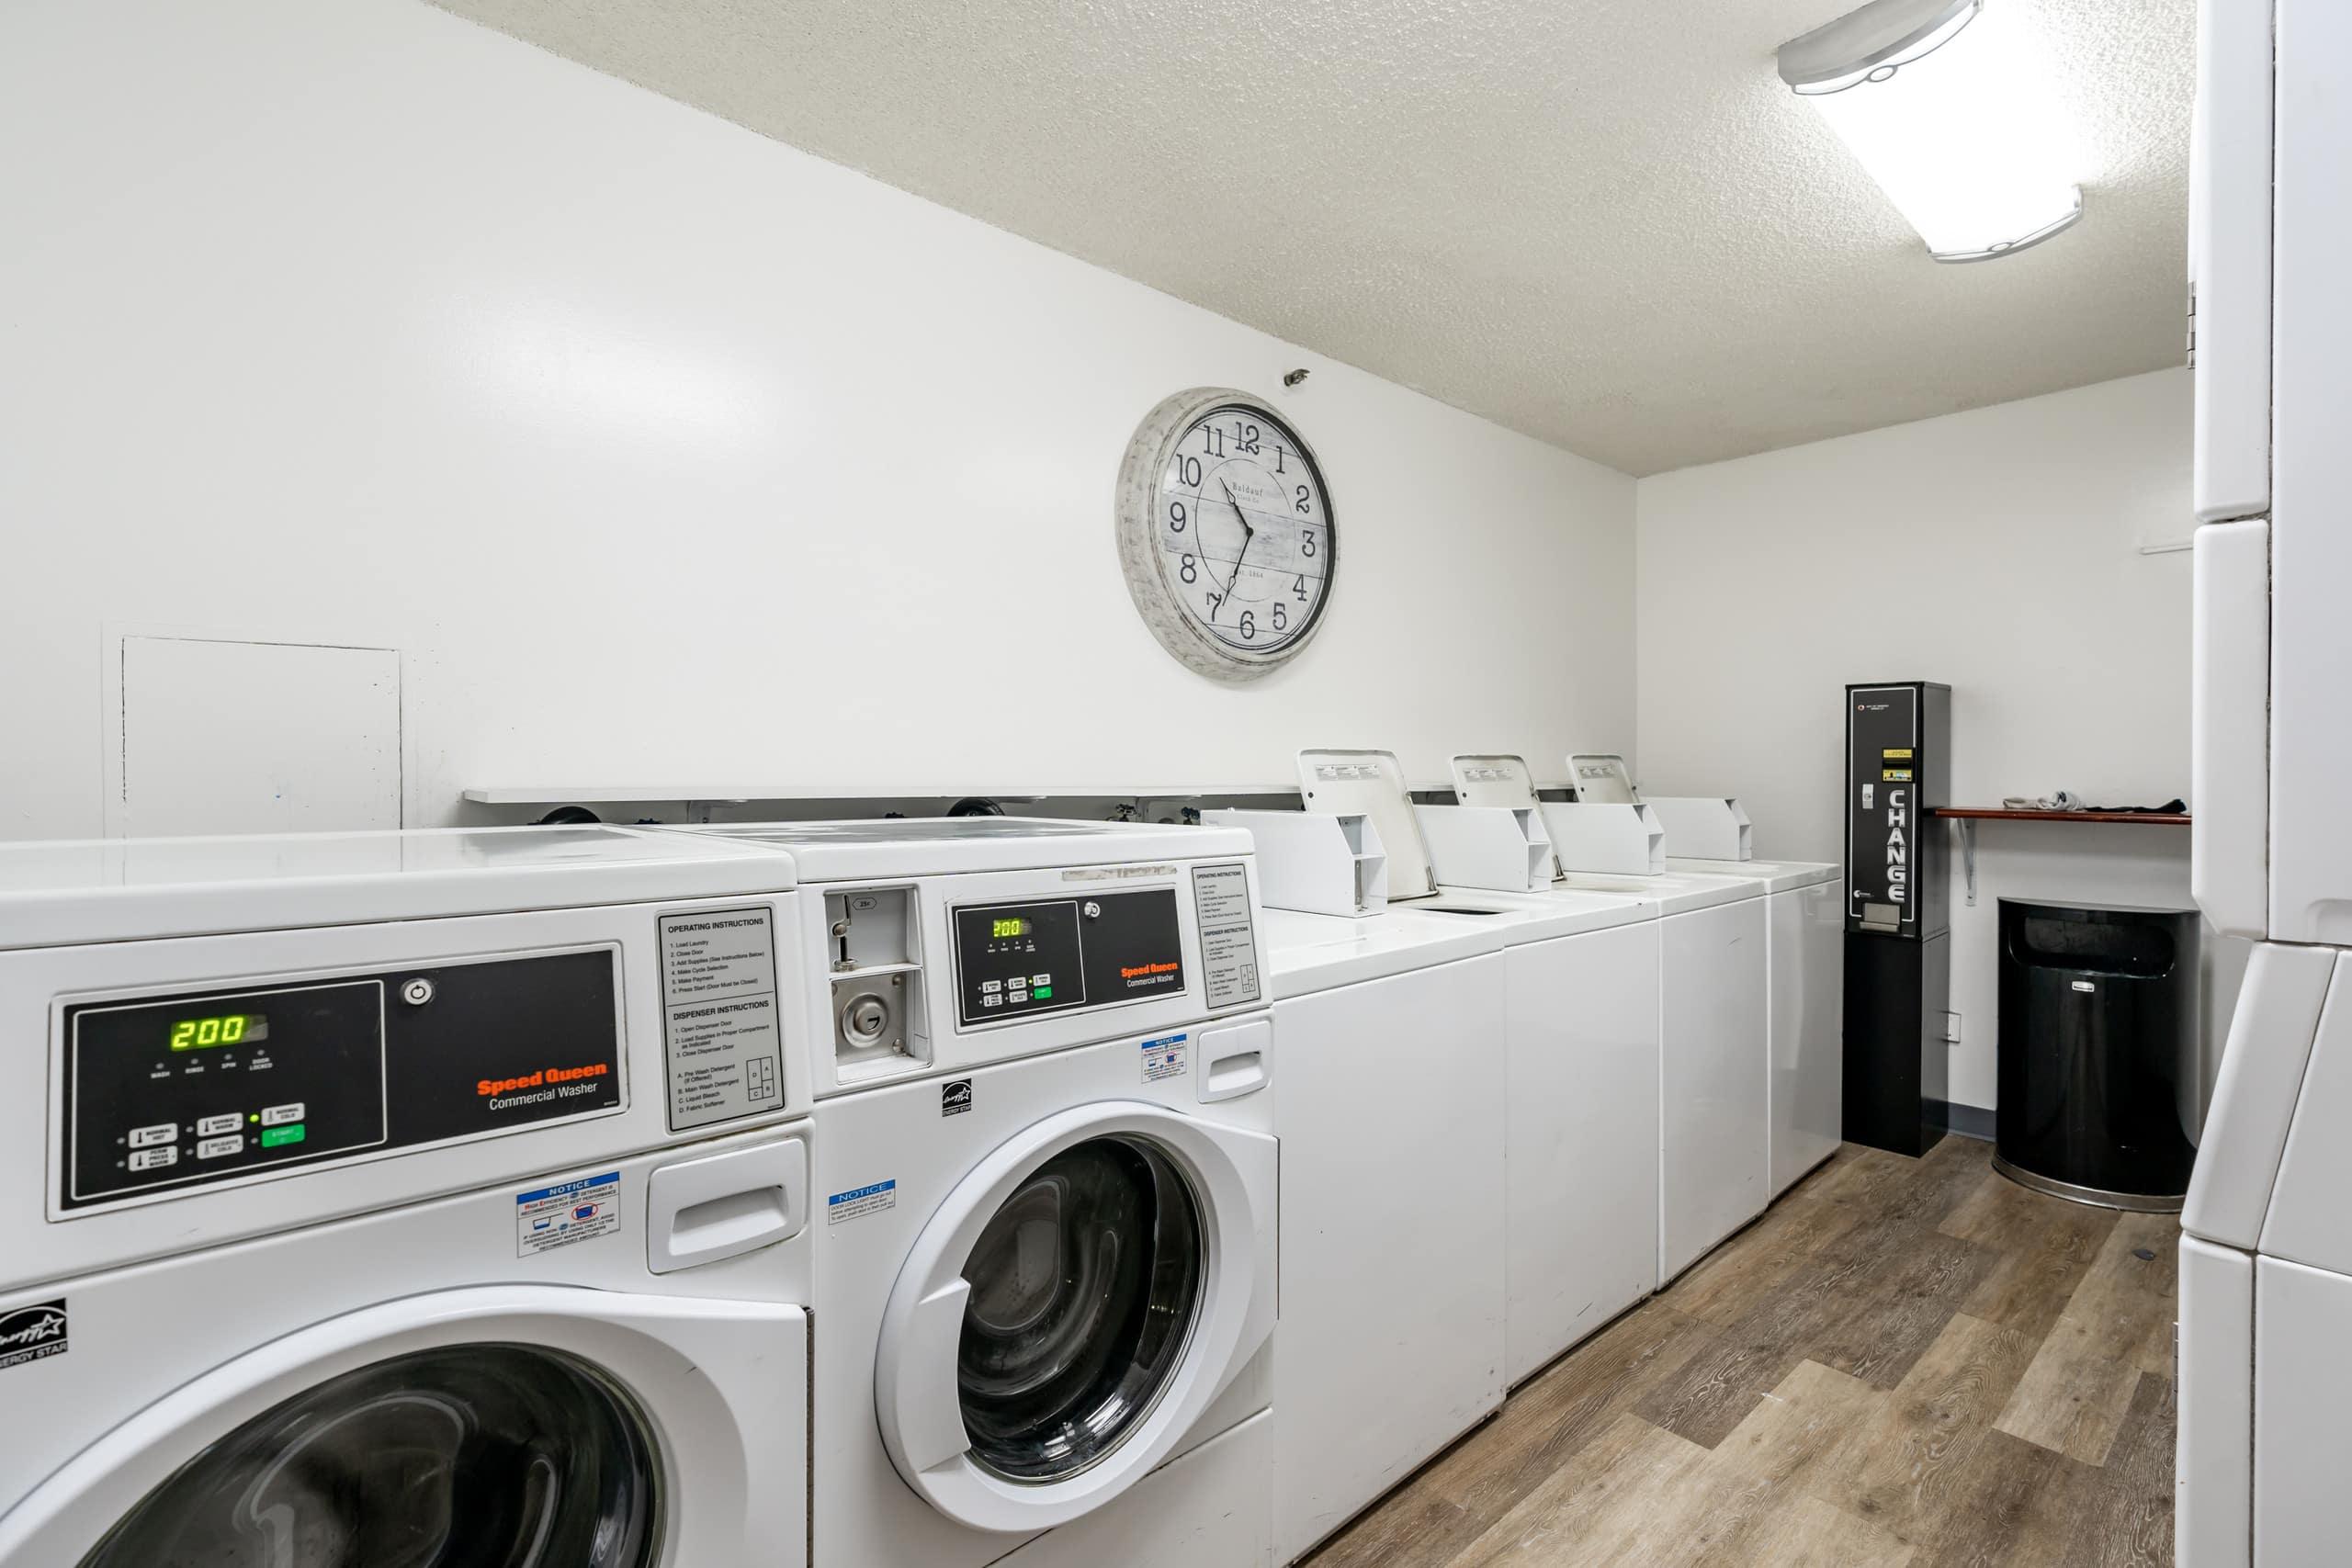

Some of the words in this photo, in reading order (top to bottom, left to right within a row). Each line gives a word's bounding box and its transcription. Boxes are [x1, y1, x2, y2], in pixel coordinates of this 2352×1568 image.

[1203, 424, 1226, 458] 11
[1235, 421, 1261, 455] 12
[1176, 454, 1203, 487] 10
[1275, 446, 1285, 474] 1
[1232, 481, 1263, 497] Baldauf
[1295, 485, 1310, 514] 2
[1170, 501, 1187, 533] 9
[1302, 530, 1316, 558] 3
[1181, 554, 1196, 584] 8
[1292, 574, 1307, 602] 4
[1205, 592, 1222, 623] 7
[1272, 603, 1287, 631] 5
[1239, 610, 1255, 640] 6
[1886, 789, 1906, 904] CHANGE
[668, 922, 711, 934] OPERATING
[712, 918, 764, 929] INSTRUCTIONS
[693, 975, 714, 983] Payment
[1121, 964, 1149, 978] Speed
[1150, 962, 1178, 973] Queen
[1126, 976, 1156, 987] Commercial
[1157, 974, 1174, 983] Washer
[673, 1008, 716, 1021] DISPENSER
[717, 1000, 769, 1013] INSTRUCTIONS
[172, 1017, 244, 1048] 200
[695, 1021, 719, 1032] Dispenser
[477, 1071, 543, 1096] Speed
[545, 1063, 607, 1083] Queen
[695, 1067, 709, 1076] Wash
[710, 1064, 736, 1073] Detergent
[489, 1089, 556, 1111] Commercial
[558, 1082, 598, 1099] Washer
[699, 1083, 714, 1091] Wash
[715, 1078, 739, 1088] Detergent
[686, 1103, 703, 1111] Fabric
[548, 1179, 591, 1195] NOTICE
[839, 1183, 888, 1201] NOTICE
[37, 1342, 67, 1359] STAR
